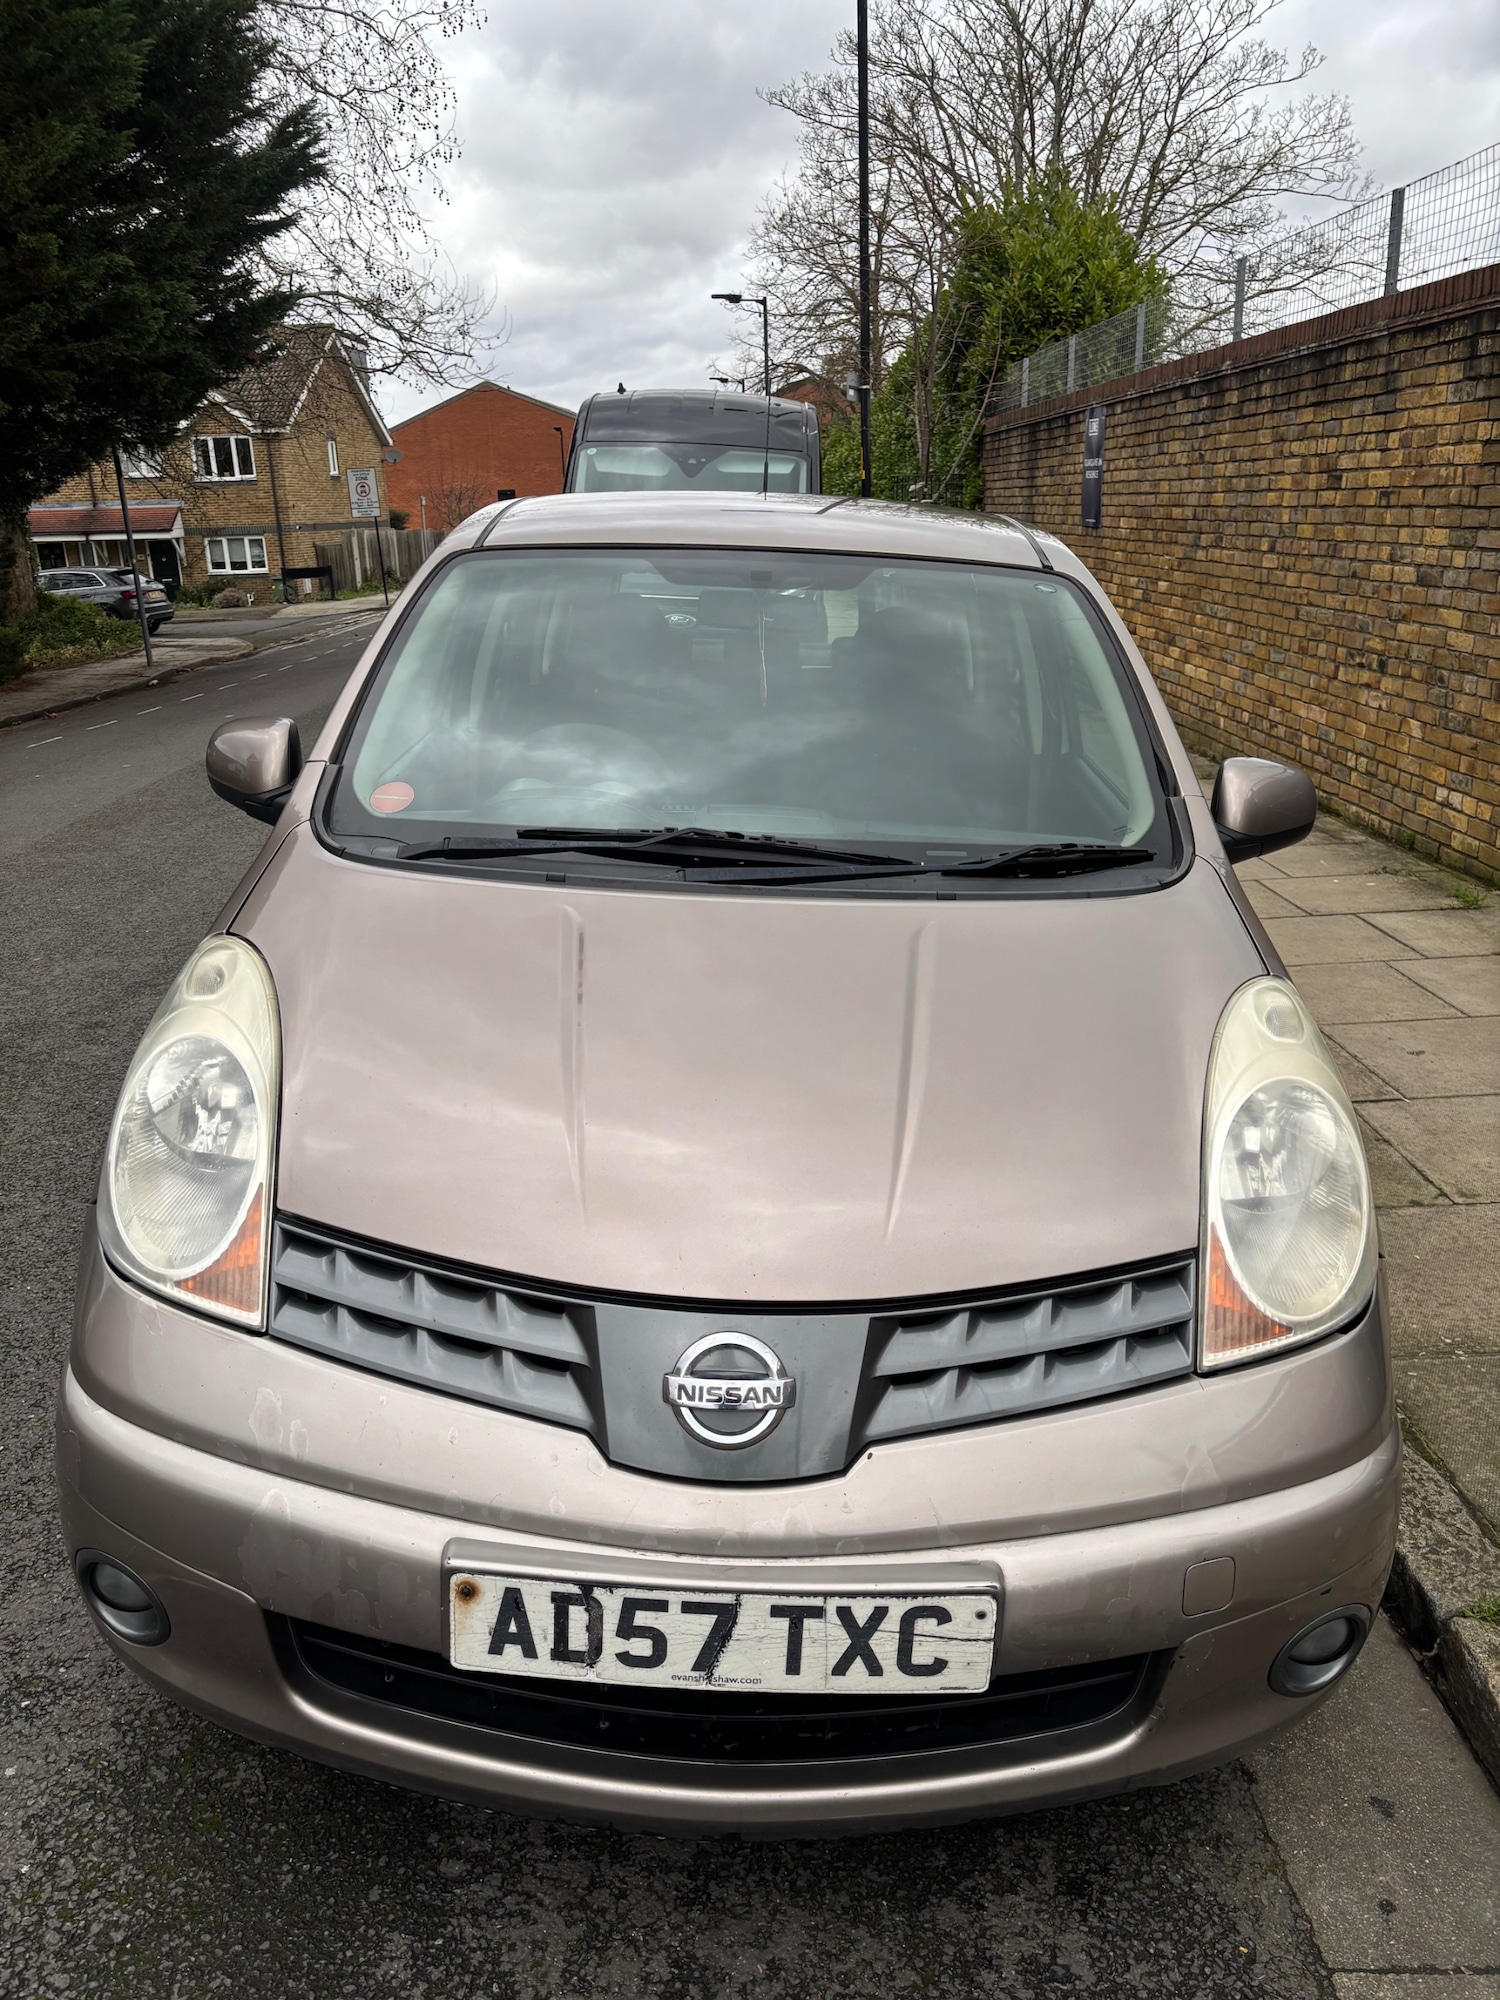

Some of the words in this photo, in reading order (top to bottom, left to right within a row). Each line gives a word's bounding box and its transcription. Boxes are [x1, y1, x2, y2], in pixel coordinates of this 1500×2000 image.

[677, 1383, 782, 1404] NISSAN
[487, 1586, 738, 1672] AD57
[769, 1604, 953, 1677] TXC
[671, 1674, 762, 1685] evanshshaw.com
